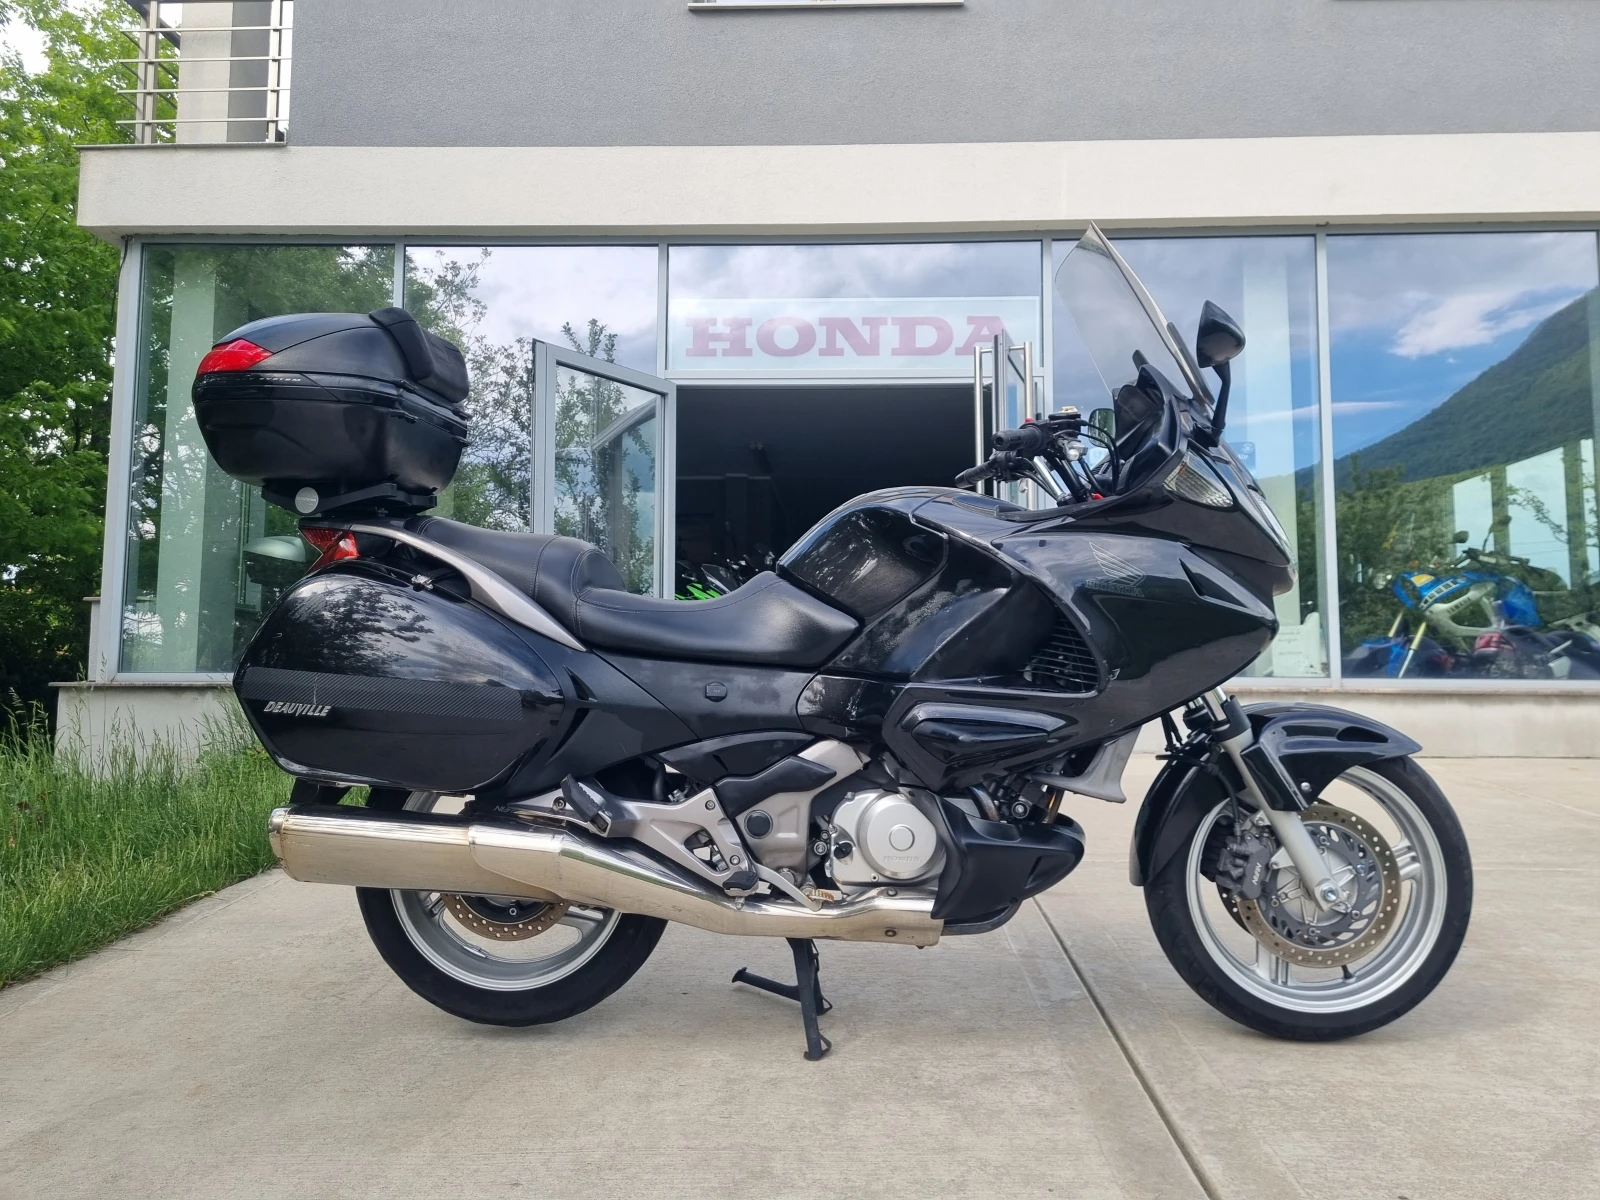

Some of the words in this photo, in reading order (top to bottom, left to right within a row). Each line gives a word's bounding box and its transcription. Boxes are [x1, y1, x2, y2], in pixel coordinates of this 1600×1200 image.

[685, 316, 1010, 357] HONDA
[1085, 579, 1145, 597] HONDA
[263, 701, 331, 716] DEAUVILLE
